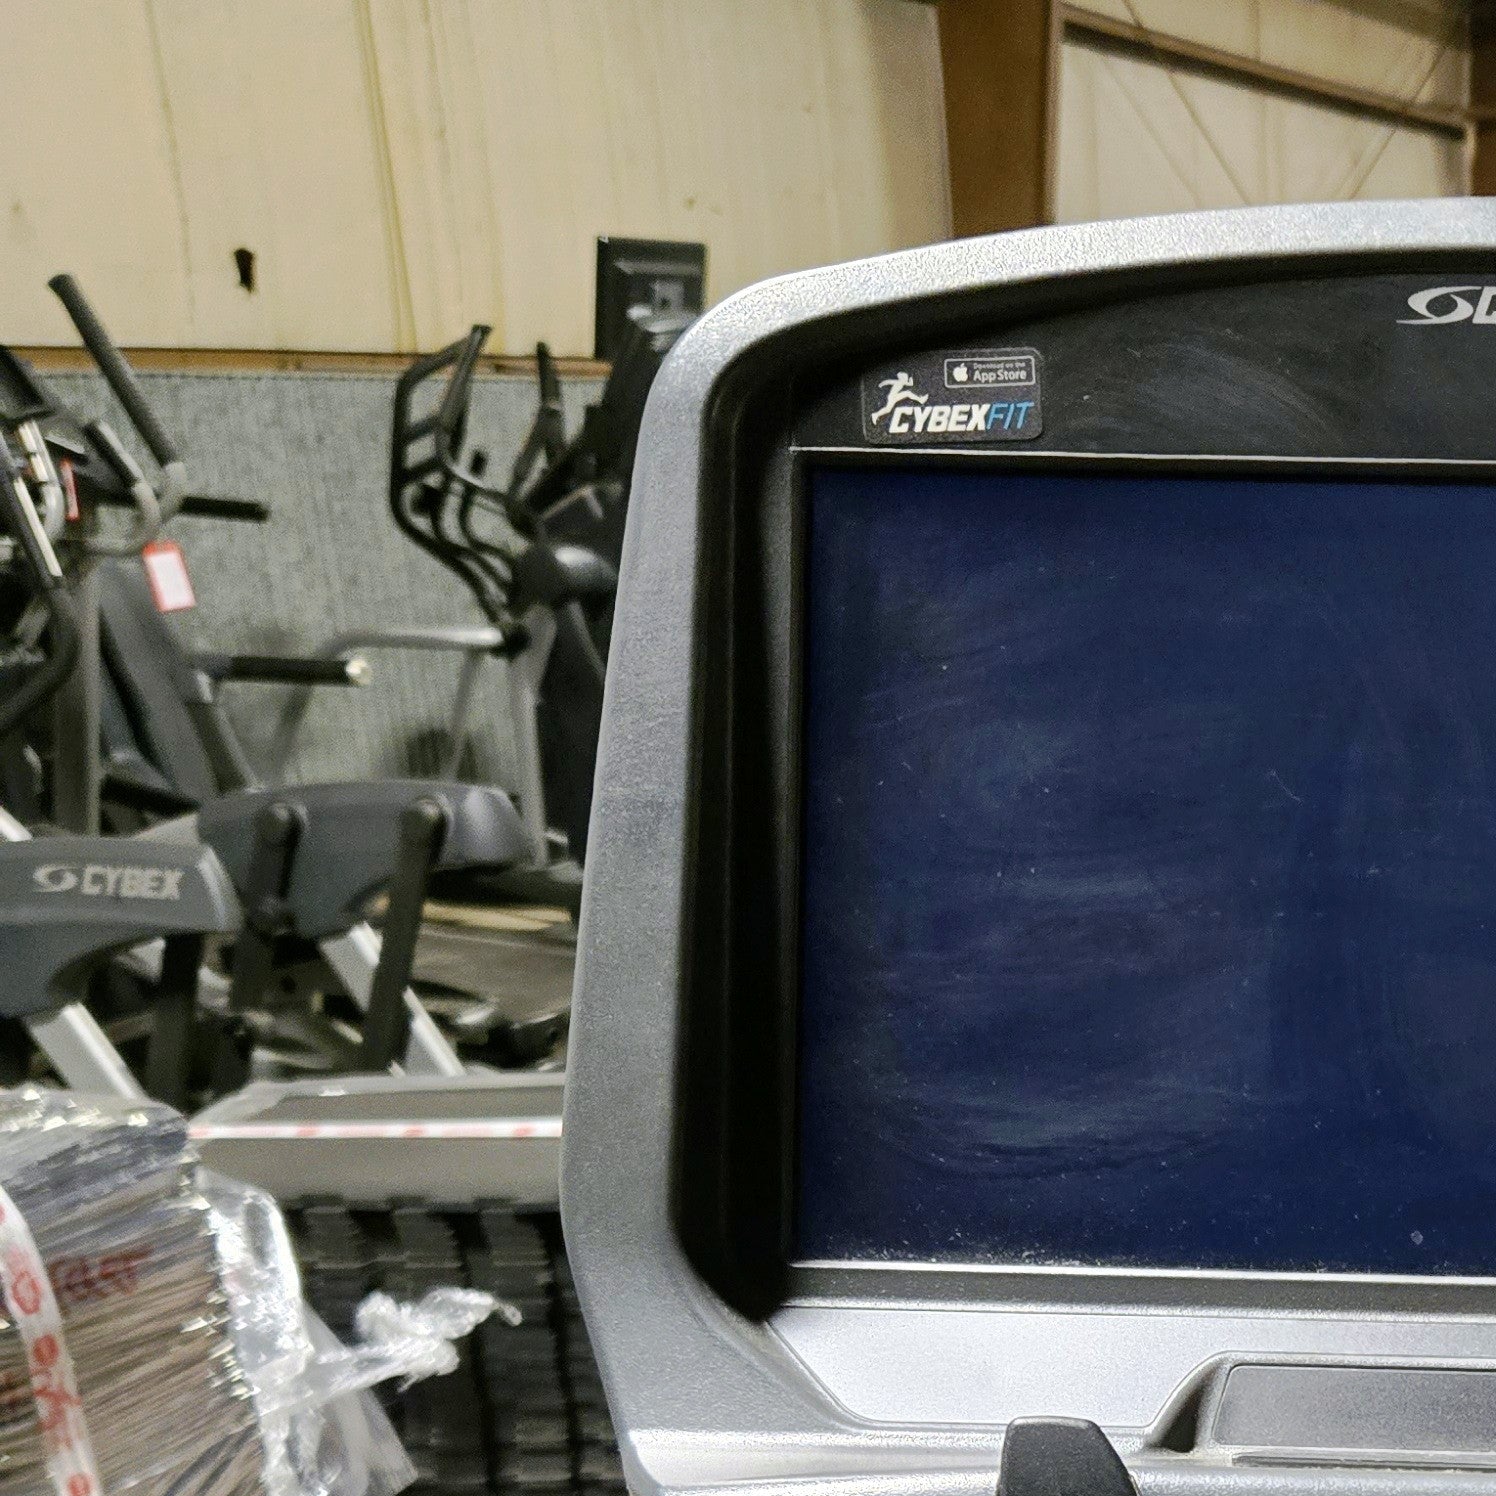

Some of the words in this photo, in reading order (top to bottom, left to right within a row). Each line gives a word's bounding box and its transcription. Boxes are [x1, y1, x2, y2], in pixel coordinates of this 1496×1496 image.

[973, 370, 997, 383] App
[997, 369, 1027, 381] Store
[889, 402, 1035, 434] CYBEXFIT
